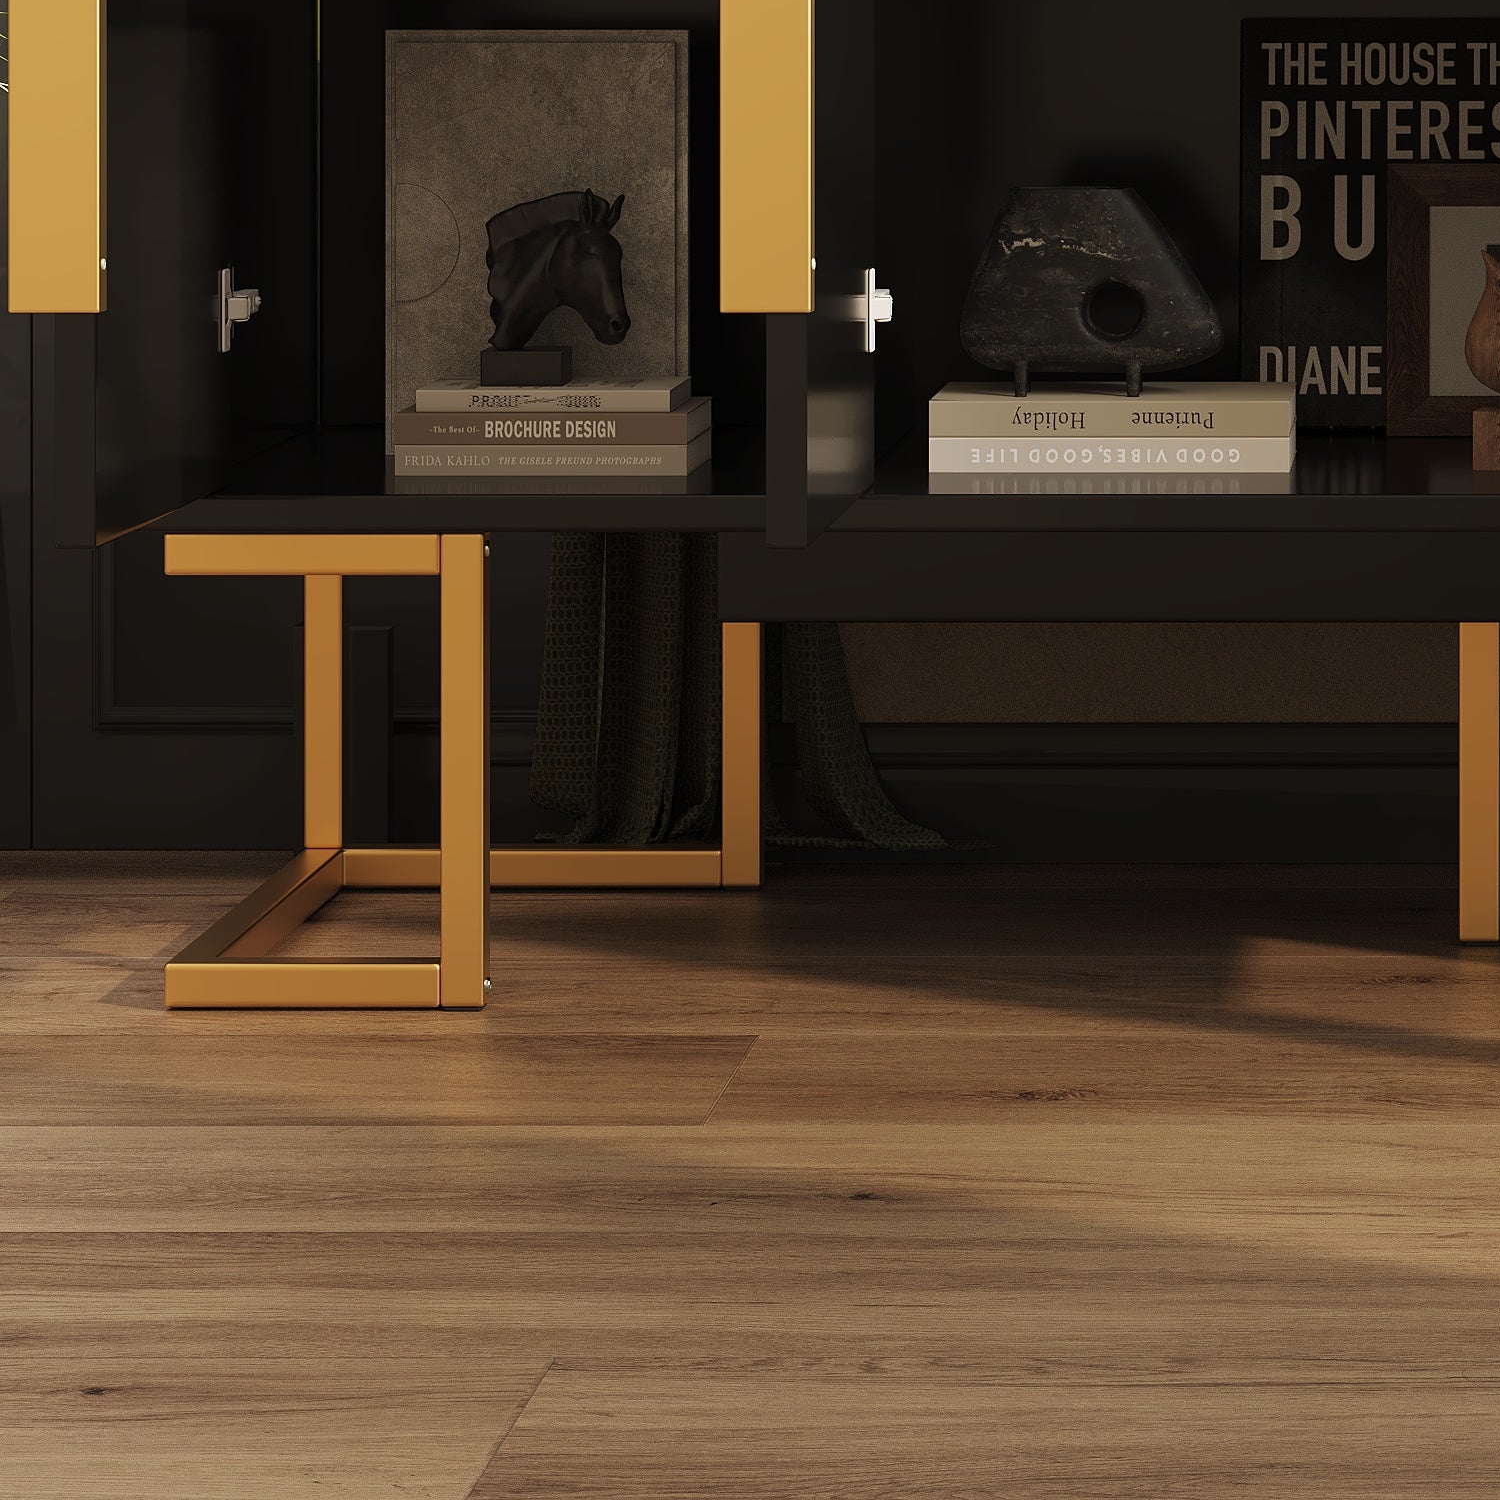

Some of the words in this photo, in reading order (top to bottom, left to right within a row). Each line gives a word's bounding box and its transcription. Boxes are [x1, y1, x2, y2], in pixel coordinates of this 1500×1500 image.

[1261, 42, 1328, 86] THE
[1340, 42, 1456, 86] HOUSE
[1259, 345, 1383, 395] DIANE
[1012, 406, 1085, 429] Holiday
[1131, 411, 1215, 429] Purienne
[449, 425, 464, 434] Best
[484, 420, 562, 439] BROCHURE
[565, 420, 616, 439] DESIGN
[404, 454, 442, 467] FRIDA
[446, 454, 491, 467] KAHLO
[498, 456, 517, 466] THE
[518, 456, 553, 466] GISELE
[555, 456, 593, 466] FREUND
[595, 456, 662, 466] PHOTOGRAPHS
[971, 448, 1018, 463] LIFE
[1029, 448, 1093, 463] GOOD
[1176, 448, 1240, 463] GOOD
